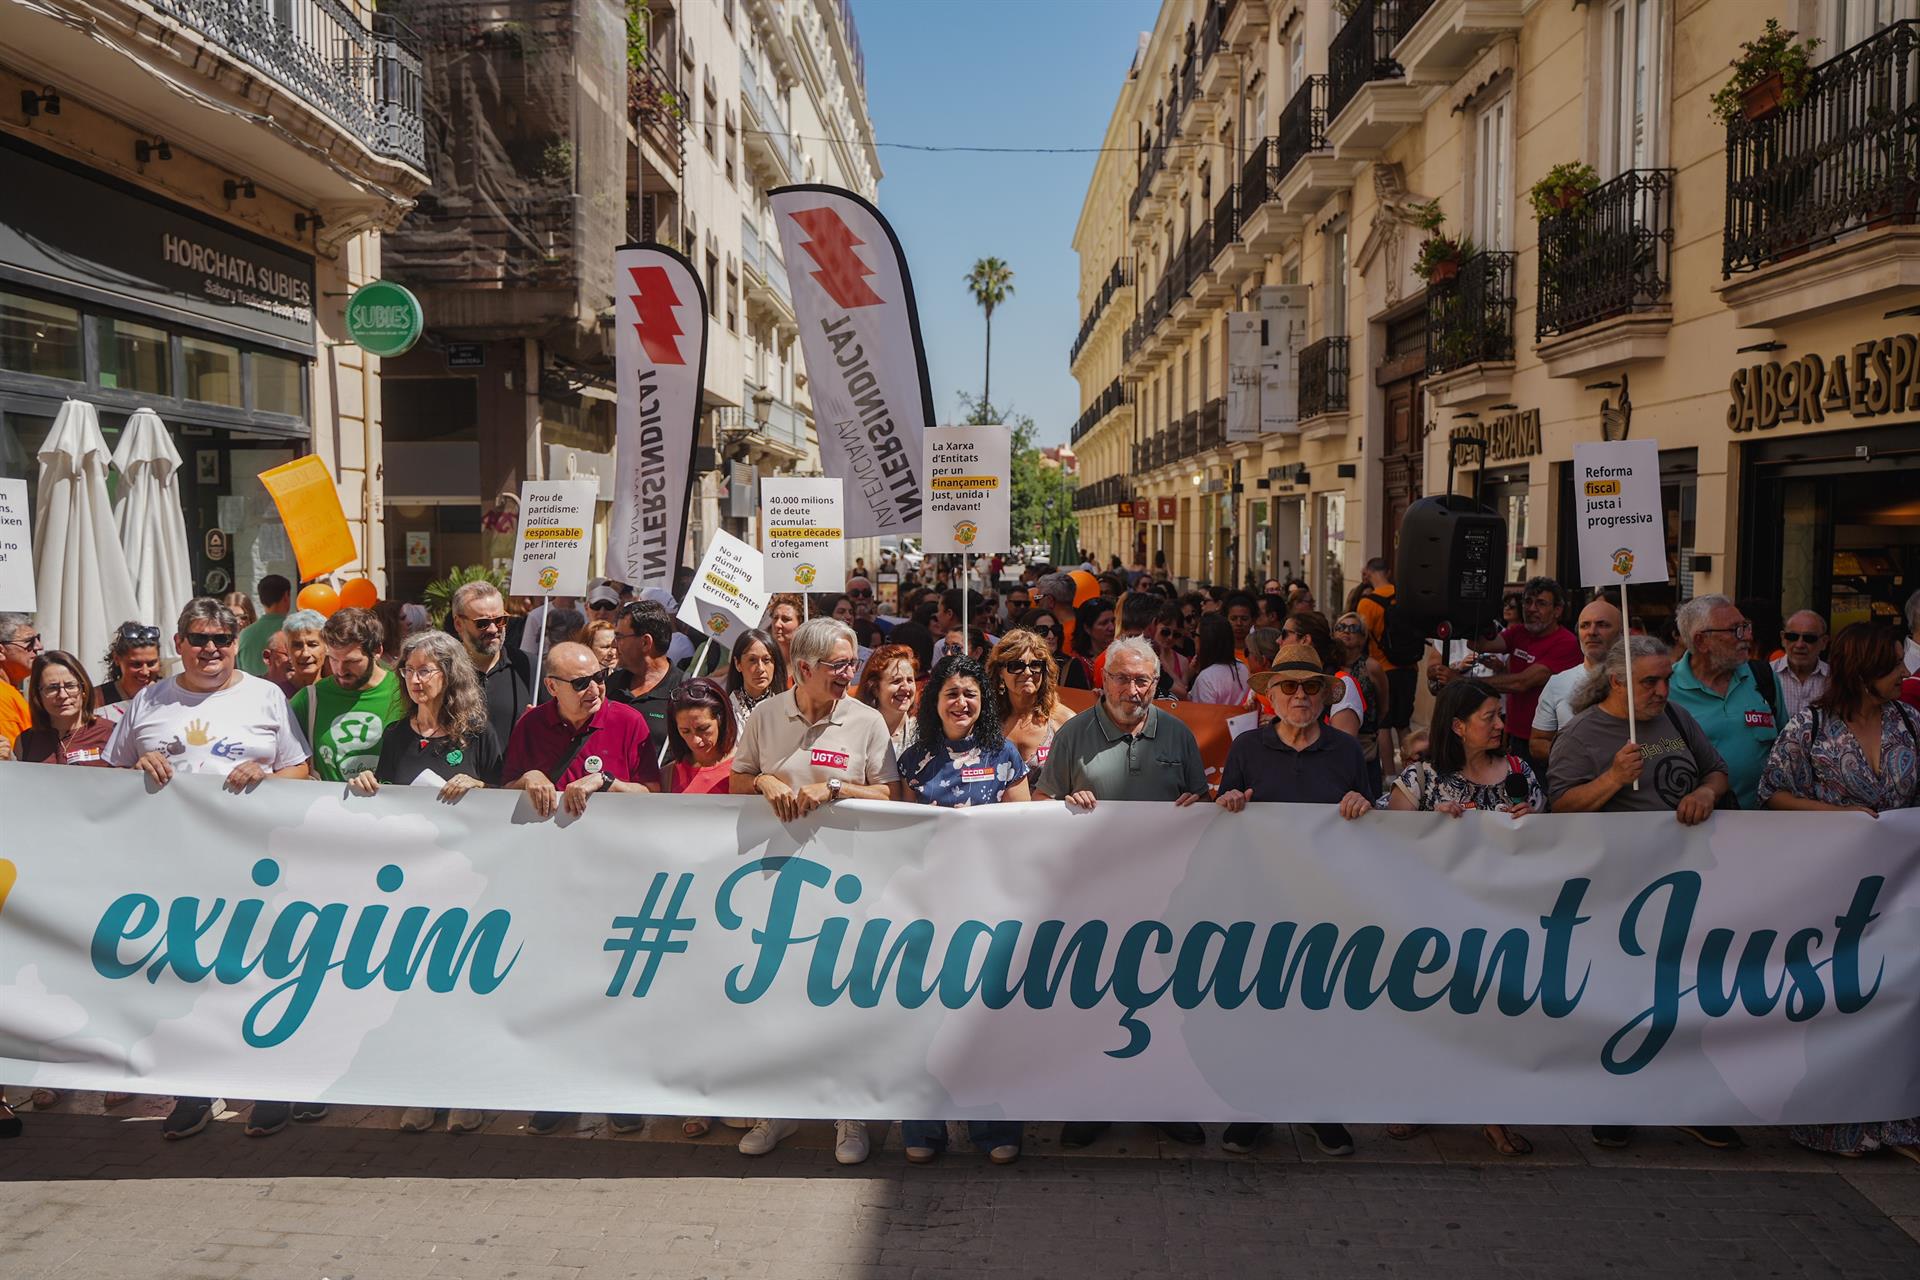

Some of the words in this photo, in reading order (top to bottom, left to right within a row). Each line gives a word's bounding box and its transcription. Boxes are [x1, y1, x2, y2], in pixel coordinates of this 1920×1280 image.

[163, 233, 256, 288] HORCHATA
[258, 267, 310, 305] SUBIES
[352, 304, 410, 330] SUBIES
[1727, 353, 1825, 433] SABOR
[1822, 354, 1850, 413] A
[932, 442, 944, 451] La
[946, 442, 974, 451] Xarxa
[932, 454, 979, 463] d'Entitats
[932, 468, 948, 477] per
[1586, 466, 1633, 478] Reforma
[932, 478, 997, 489] Finançament
[1586, 482, 1616, 494] fiscal
[530, 494, 550, 502] Prou
[552, 494, 563, 502] de
[769, 496, 799, 504] 40.000
[801, 496, 834, 505] milions
[931, 491, 953, 501] Just,
[955, 490, 984, 499] unida
[986, 490, 990, 499] i
[931, 502, 981, 512] endavant!
[1586, 498, 1616, 513] justa
[1618, 497, 1622, 509] i
[528, 506, 579, 515] partidisme:
[770, 507, 782, 515] de
[783, 507, 810, 515] deute
[527, 517, 559, 527] política
[770, 518, 817, 526] acumulat:
[1588, 512, 1653, 529] progressiva
[525, 528, 580, 538] responsable
[770, 529, 802, 538] quatre
[803, 528, 841, 537] dècades
[524, 541, 539, 550] per
[771, 540, 829, 549] d'ofegament
[523, 552, 556, 562] general
[720, 546, 732, 557] No
[733, 555, 742, 563] al
[771, 551, 800, 559] crònic
[711, 563, 737, 583] fiscal:
[702, 582, 741, 609] territoris
[706, 573, 739, 595] equitat
[739, 592, 760, 610] entre
[1745, 714, 1762, 722] UGT
[812, 752, 834, 762] UGT
[90, 858, 525, 1048] exigim
